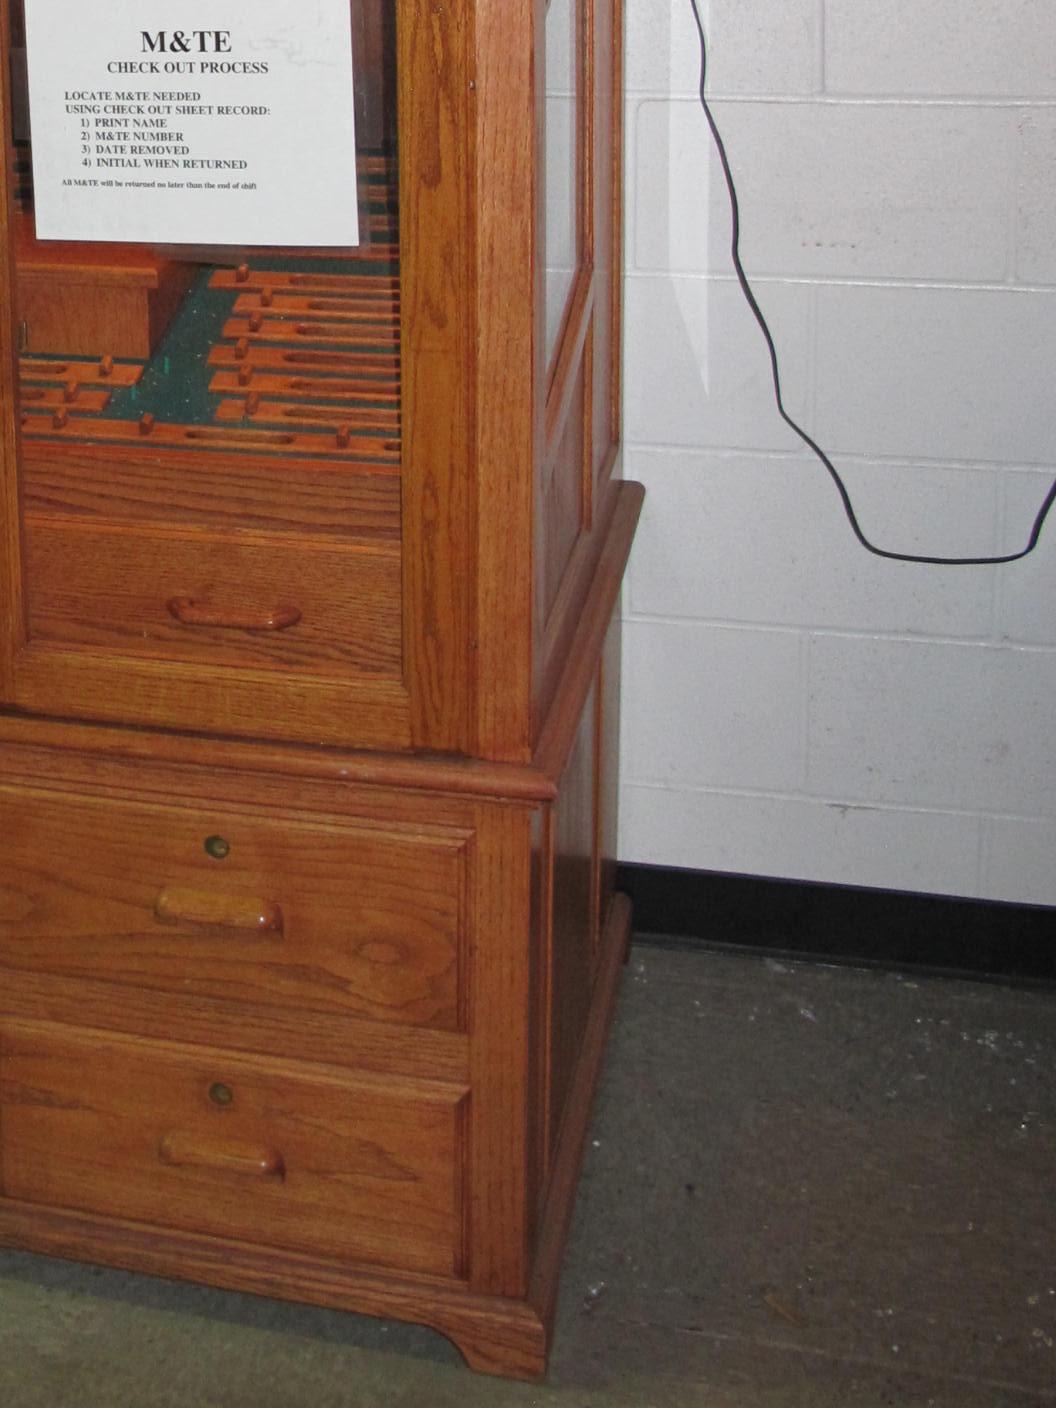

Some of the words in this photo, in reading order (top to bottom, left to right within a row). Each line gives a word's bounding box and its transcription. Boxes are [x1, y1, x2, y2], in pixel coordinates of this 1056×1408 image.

[140, 30, 232, 53] M&TE
[106, 61, 161, 74] CHECK
[163, 61, 196, 74] OUT
[200, 61, 269, 74] PROCESS
[64, 91, 113, 101] LOCATE
[114, 91, 151, 101] M&TE
[152, 91, 202, 102] NEEDED
[65, 104, 101, 115] USING
[103, 104, 146, 115] CHECK
[147, 104, 173, 115] OUT
[175, 105, 215, 115] SHEET
[216, 105, 271, 116] RECORD:
[80, 117, 90, 129] 1)
[94, 117, 130, 128] PRINT
[132, 118, 168, 128] NAME
[80, 131, 91, 142] 2)
[95, 131, 131, 142] M&TE
[132, 131, 184, 142] NUMBER
[80, 144, 92, 155] 3)
[95, 144, 127, 155] DATE
[130, 144, 190, 156] REMOVED
[81, 158, 92, 169] 4)
[96, 158, 141, 169] INITIAL
[143, 158, 180, 169] WHEN
[182, 159, 248, 170] RETURNED
